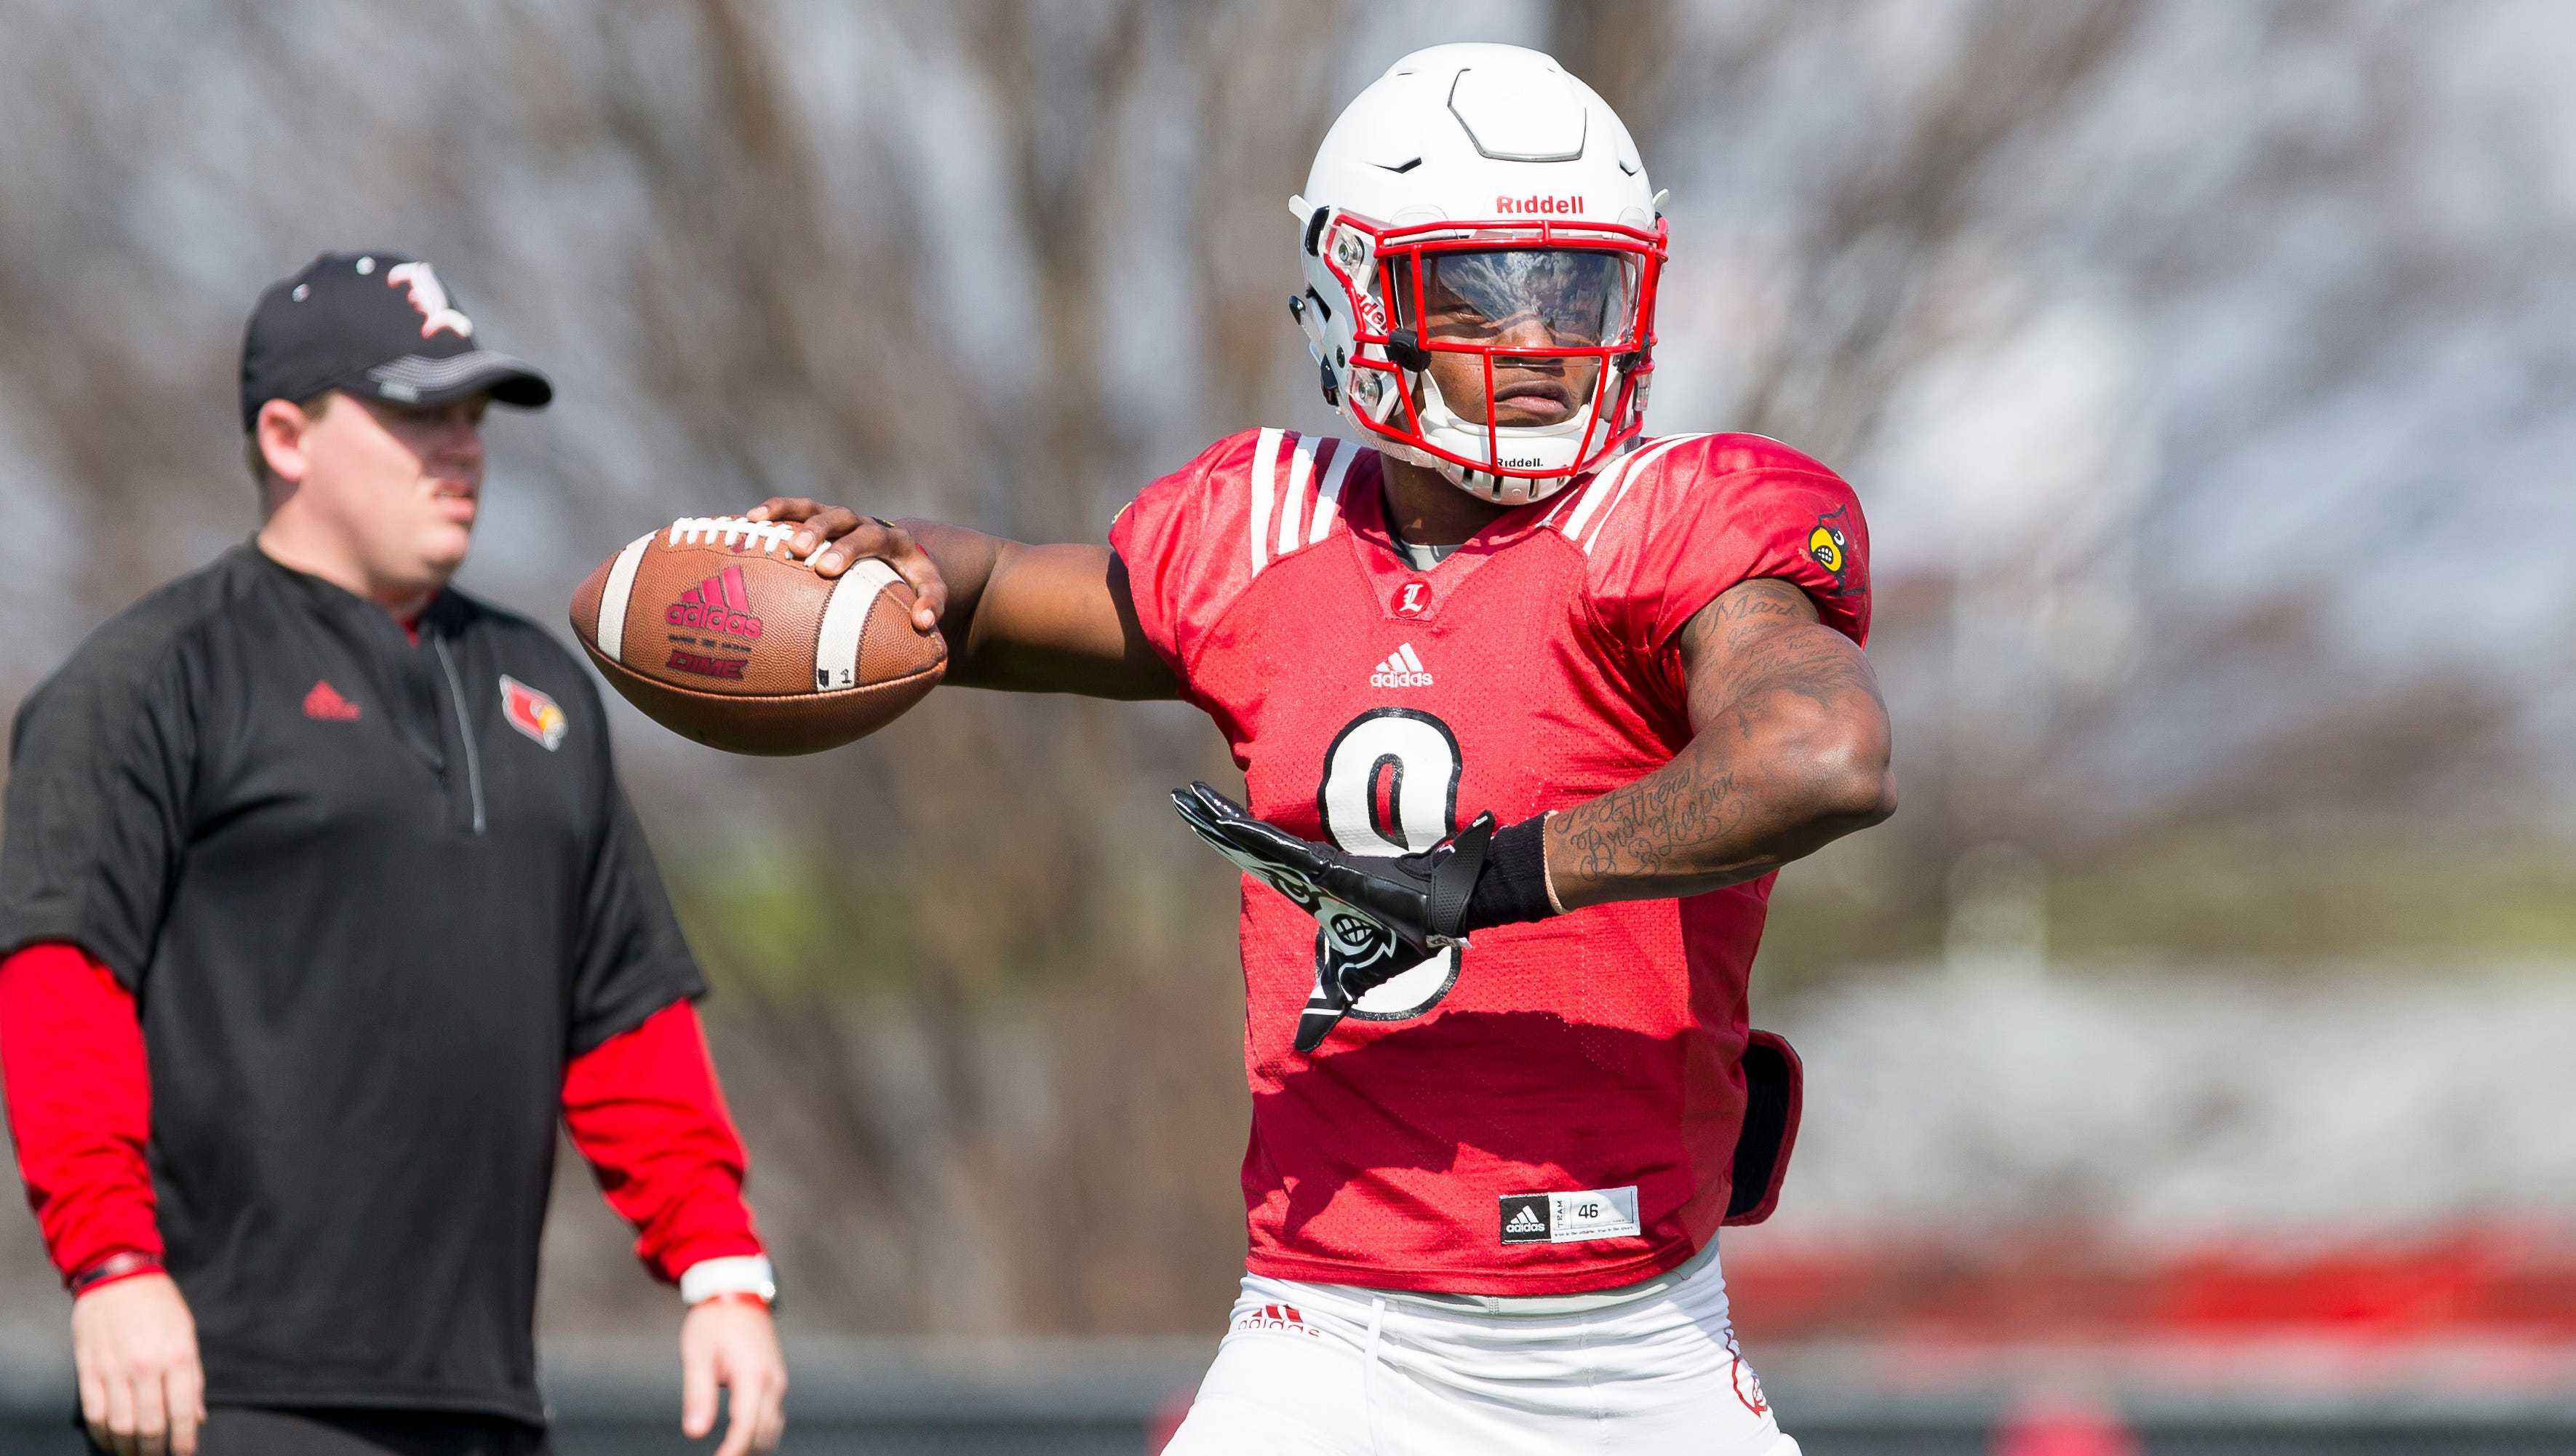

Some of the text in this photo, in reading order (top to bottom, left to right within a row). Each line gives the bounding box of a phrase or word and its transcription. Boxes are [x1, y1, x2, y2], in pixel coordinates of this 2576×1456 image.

[1496, 195, 1584, 215] Riddell
[1399, 584, 1424, 613] L
[666, 603, 762, 640] adidas
[666, 649, 749, 680] DIME
[1370, 669, 1434, 688] adidas
[1578, 1204, 1599, 1220] 46
[1506, 1222, 1546, 1233] adidas
